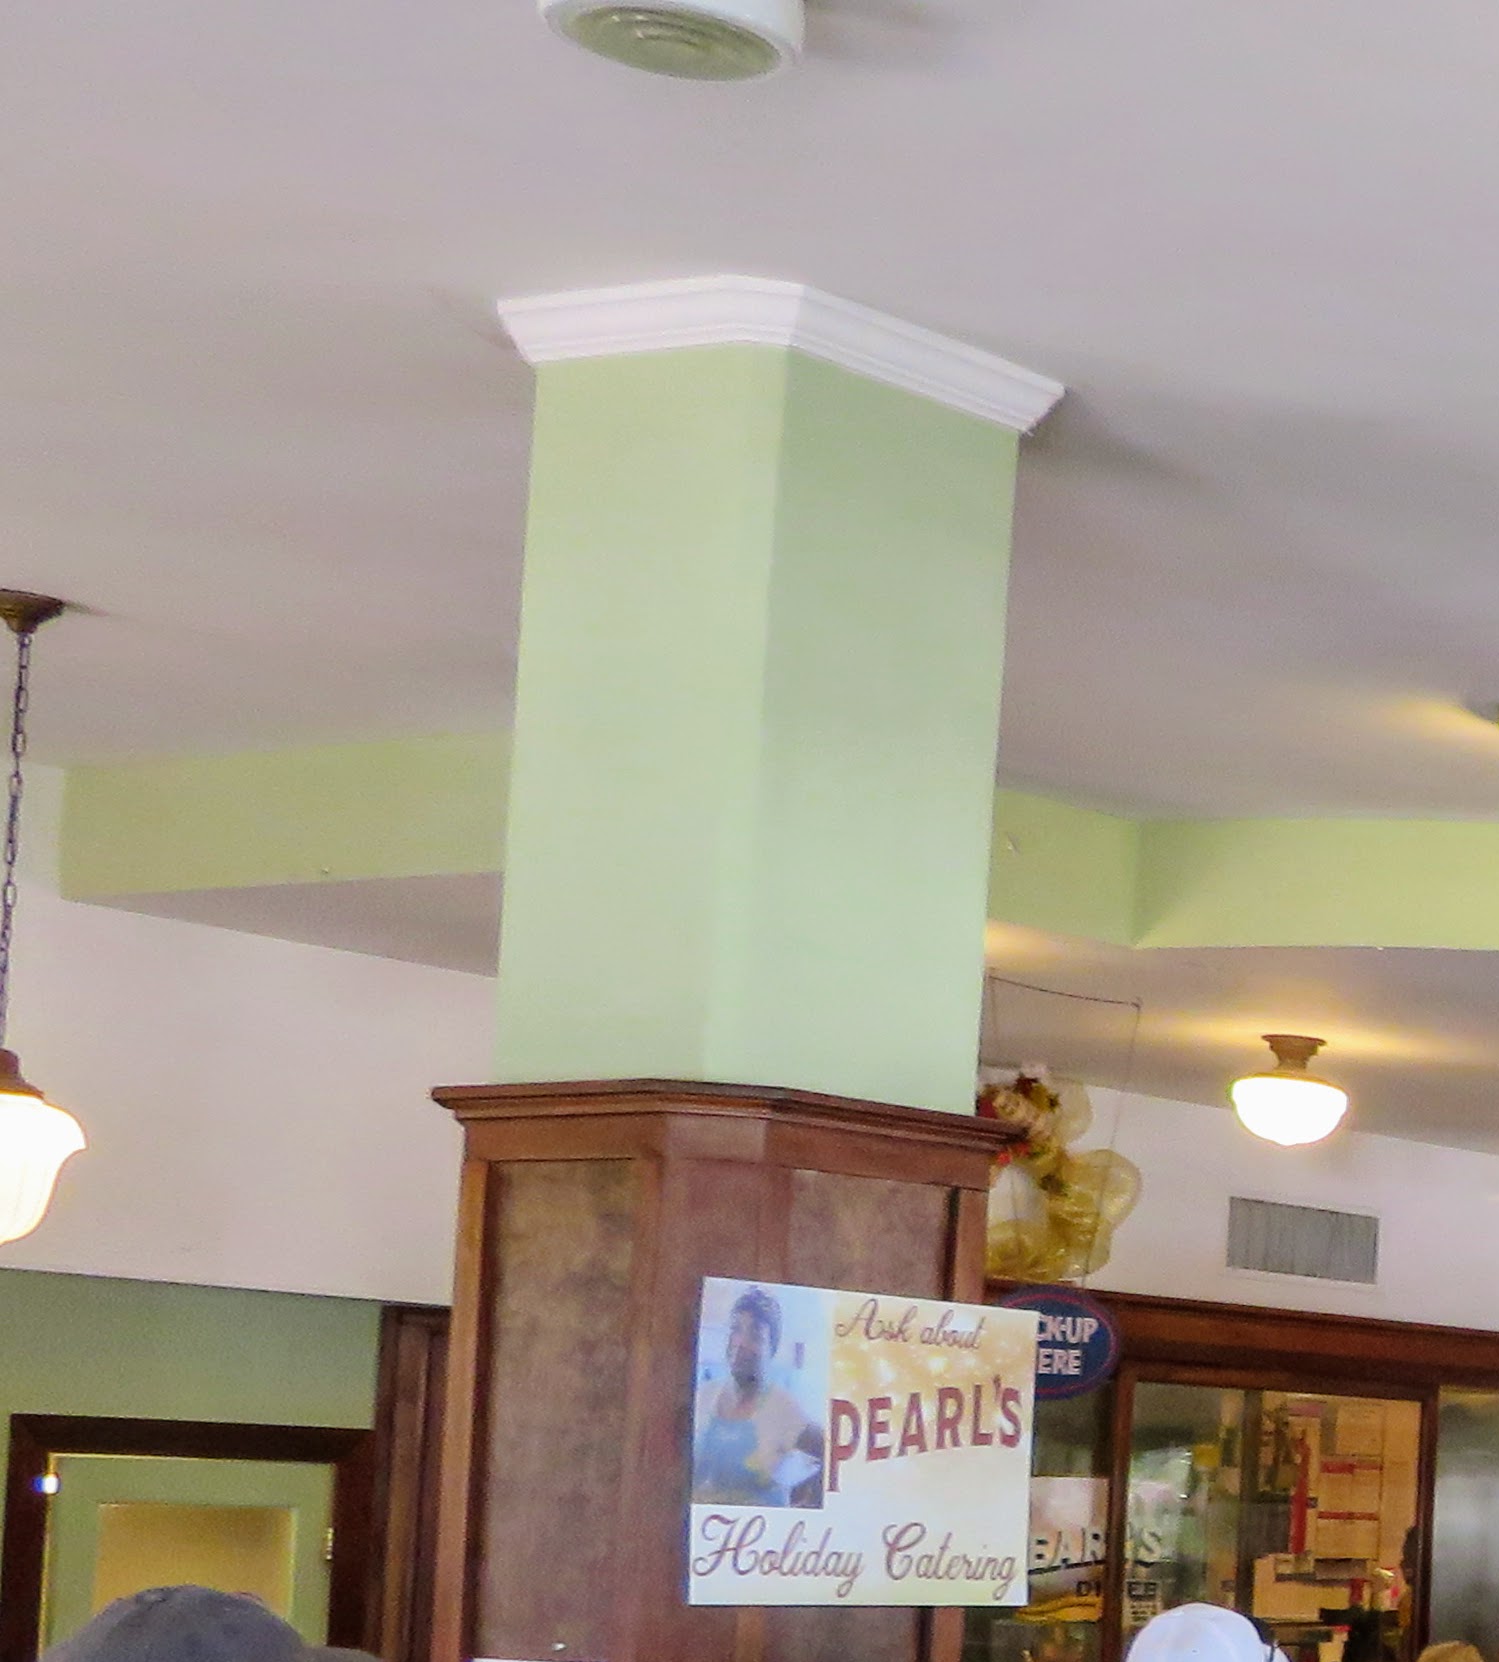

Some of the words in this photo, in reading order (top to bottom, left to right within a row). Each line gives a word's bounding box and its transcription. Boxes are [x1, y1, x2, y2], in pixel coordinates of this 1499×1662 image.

[835, 1298, 918, 1342] Ask
[920, 1309, 986, 1349] about
[1037, 1349, 1082, 1376] ERE
[826, 1374, 1022, 1492] PEARL'S
[692, 1514, 863, 1598] Holiday
[882, 1522, 1016, 1600] Catering
